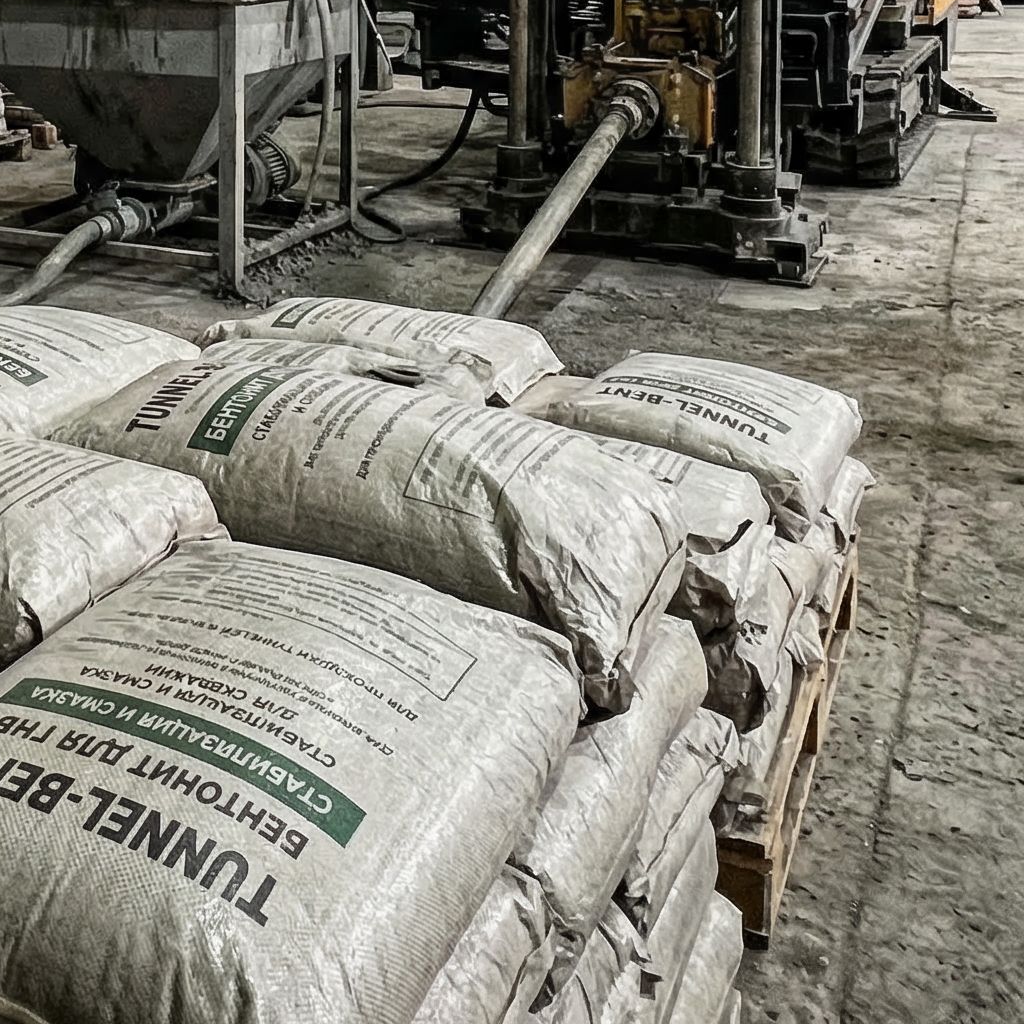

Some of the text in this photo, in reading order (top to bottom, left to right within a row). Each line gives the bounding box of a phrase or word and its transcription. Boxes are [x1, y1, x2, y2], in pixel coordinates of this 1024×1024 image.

[596, 386, 770, 445] TUNNEL-BENT
[80, 665, 154, 690] СМАЗКА
[156, 683, 172, 696] И
[30, 685, 333, 814] СТАБИЛИЗАЦИЯ И СМАЗКА
[58, 729, 135, 766] ДЛЯ
[127, 754, 310, 860] БЕНТОНИТ
